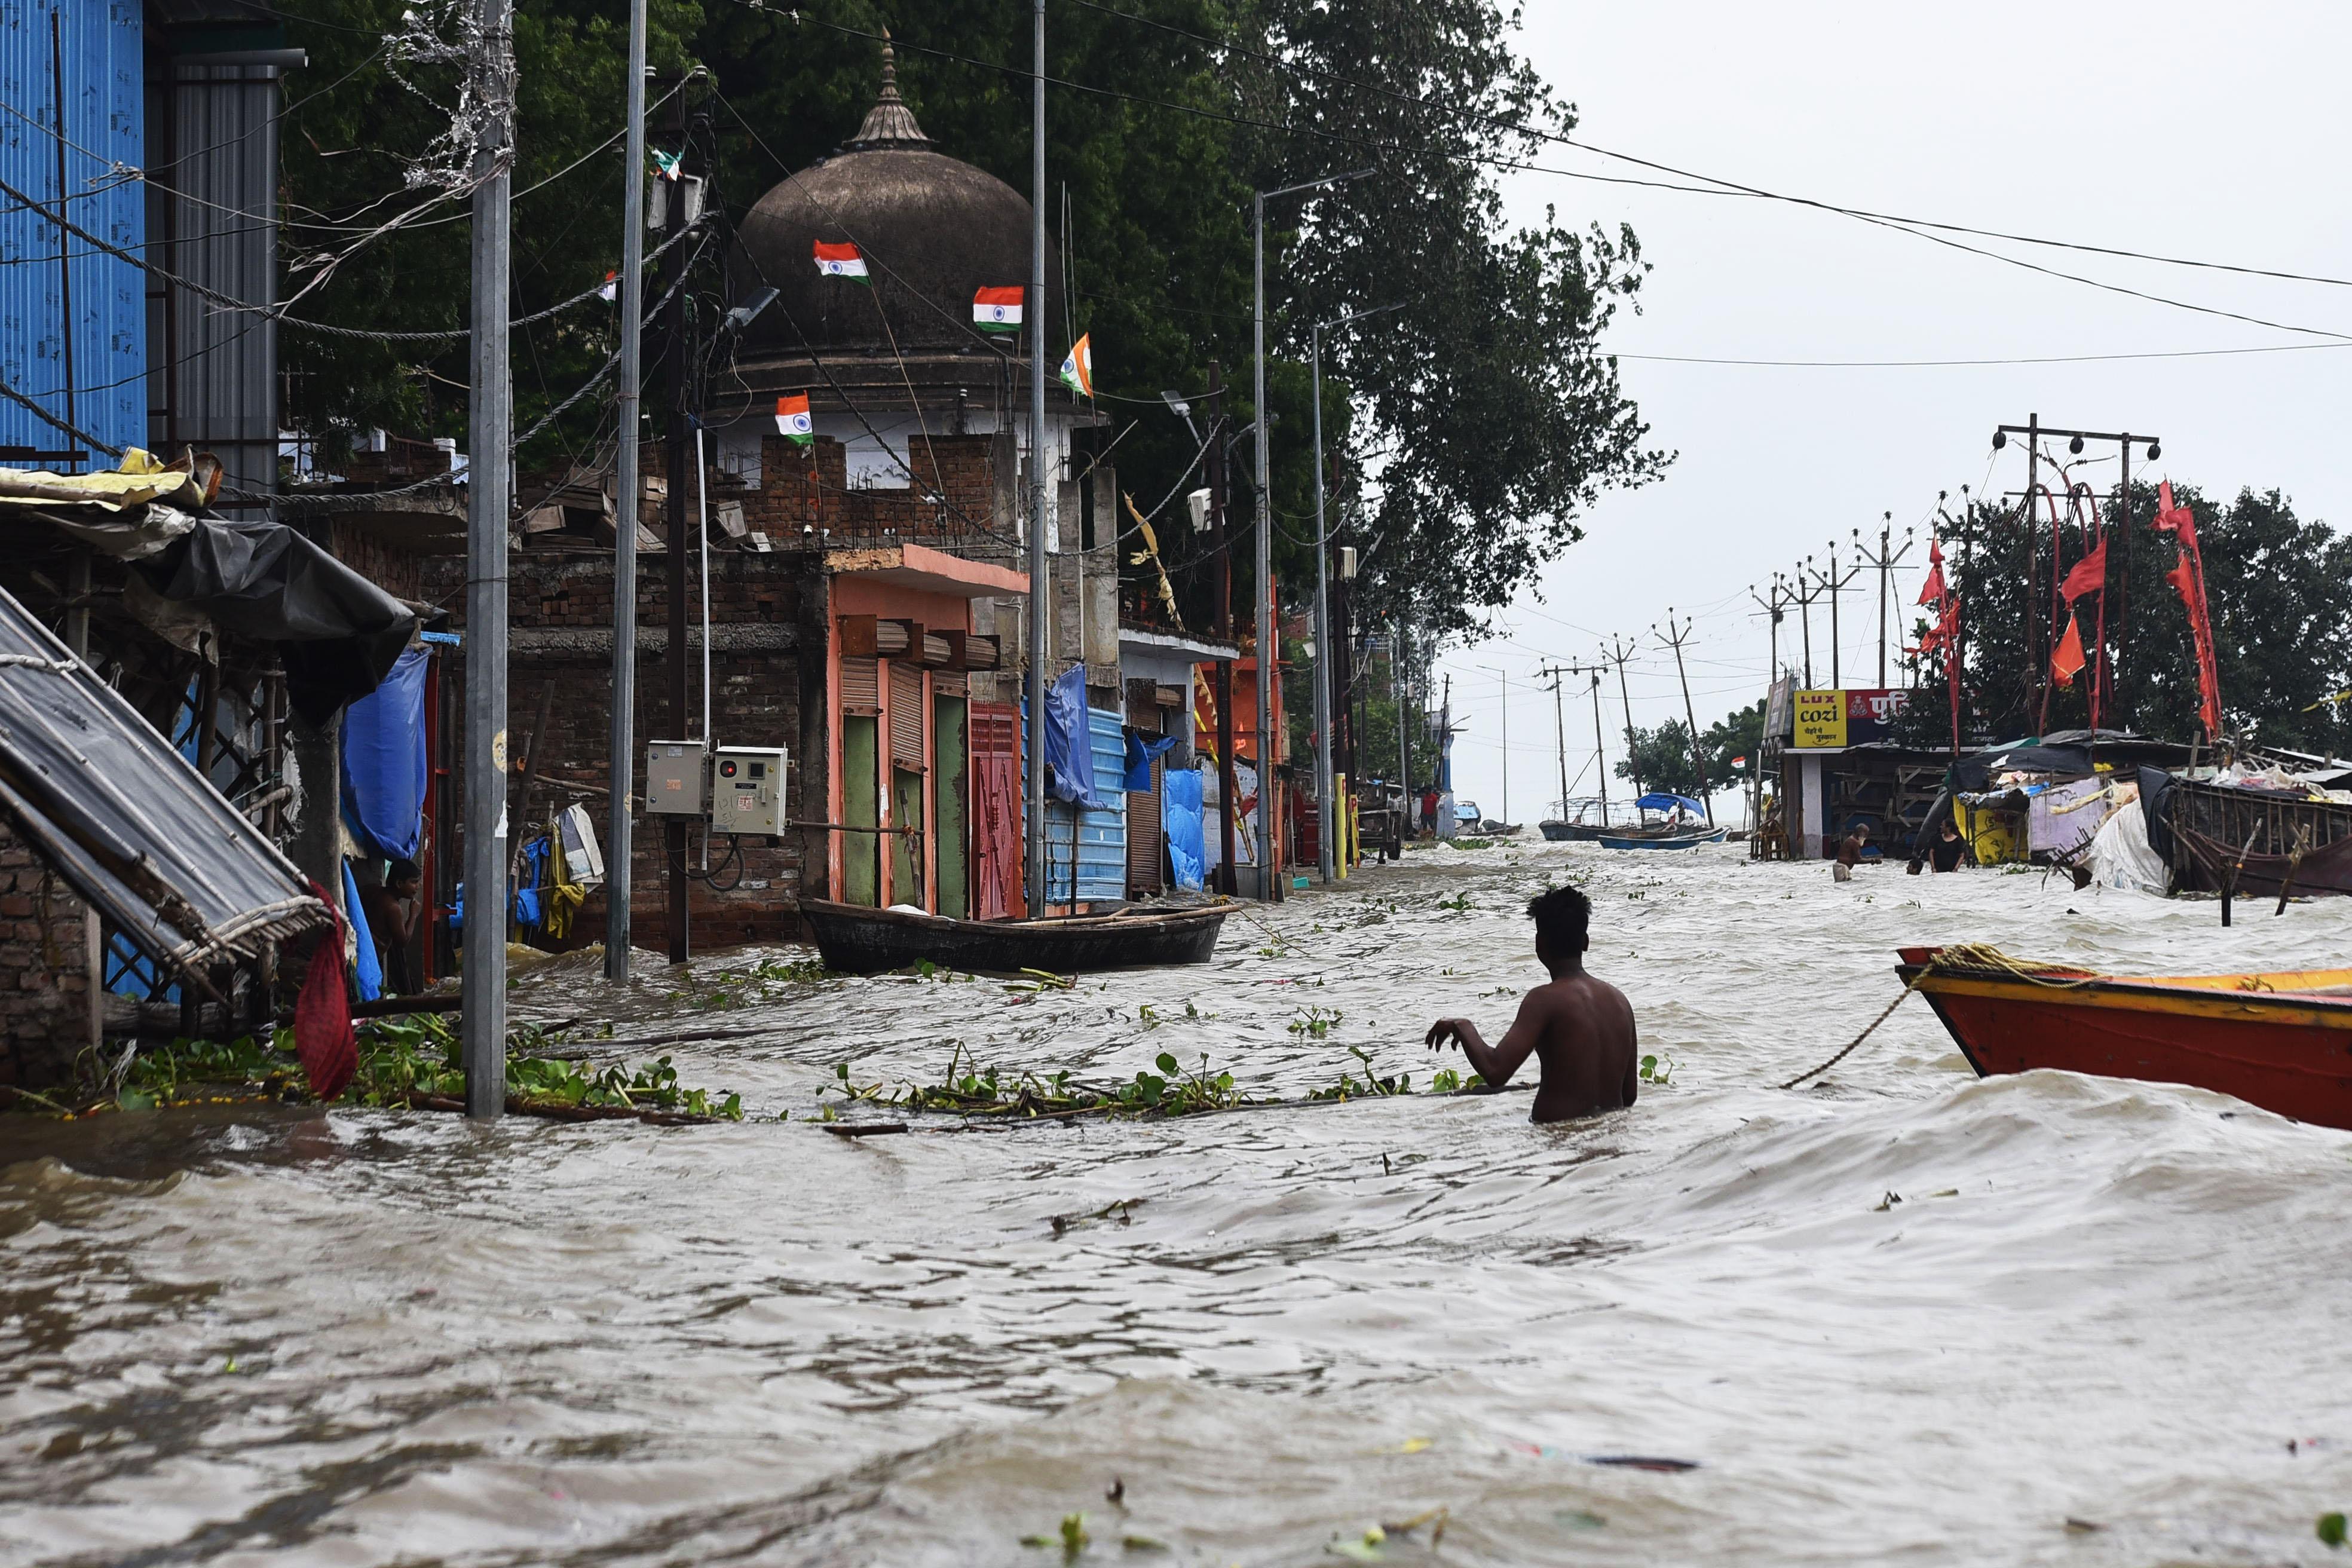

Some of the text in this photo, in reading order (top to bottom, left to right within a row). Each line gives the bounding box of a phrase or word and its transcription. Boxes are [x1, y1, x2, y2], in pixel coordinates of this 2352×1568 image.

[1800, 696, 1835, 704] LUX
[1800, 705, 1839, 722] cozi
[1816, 734, 1837, 743] मुस्कान
